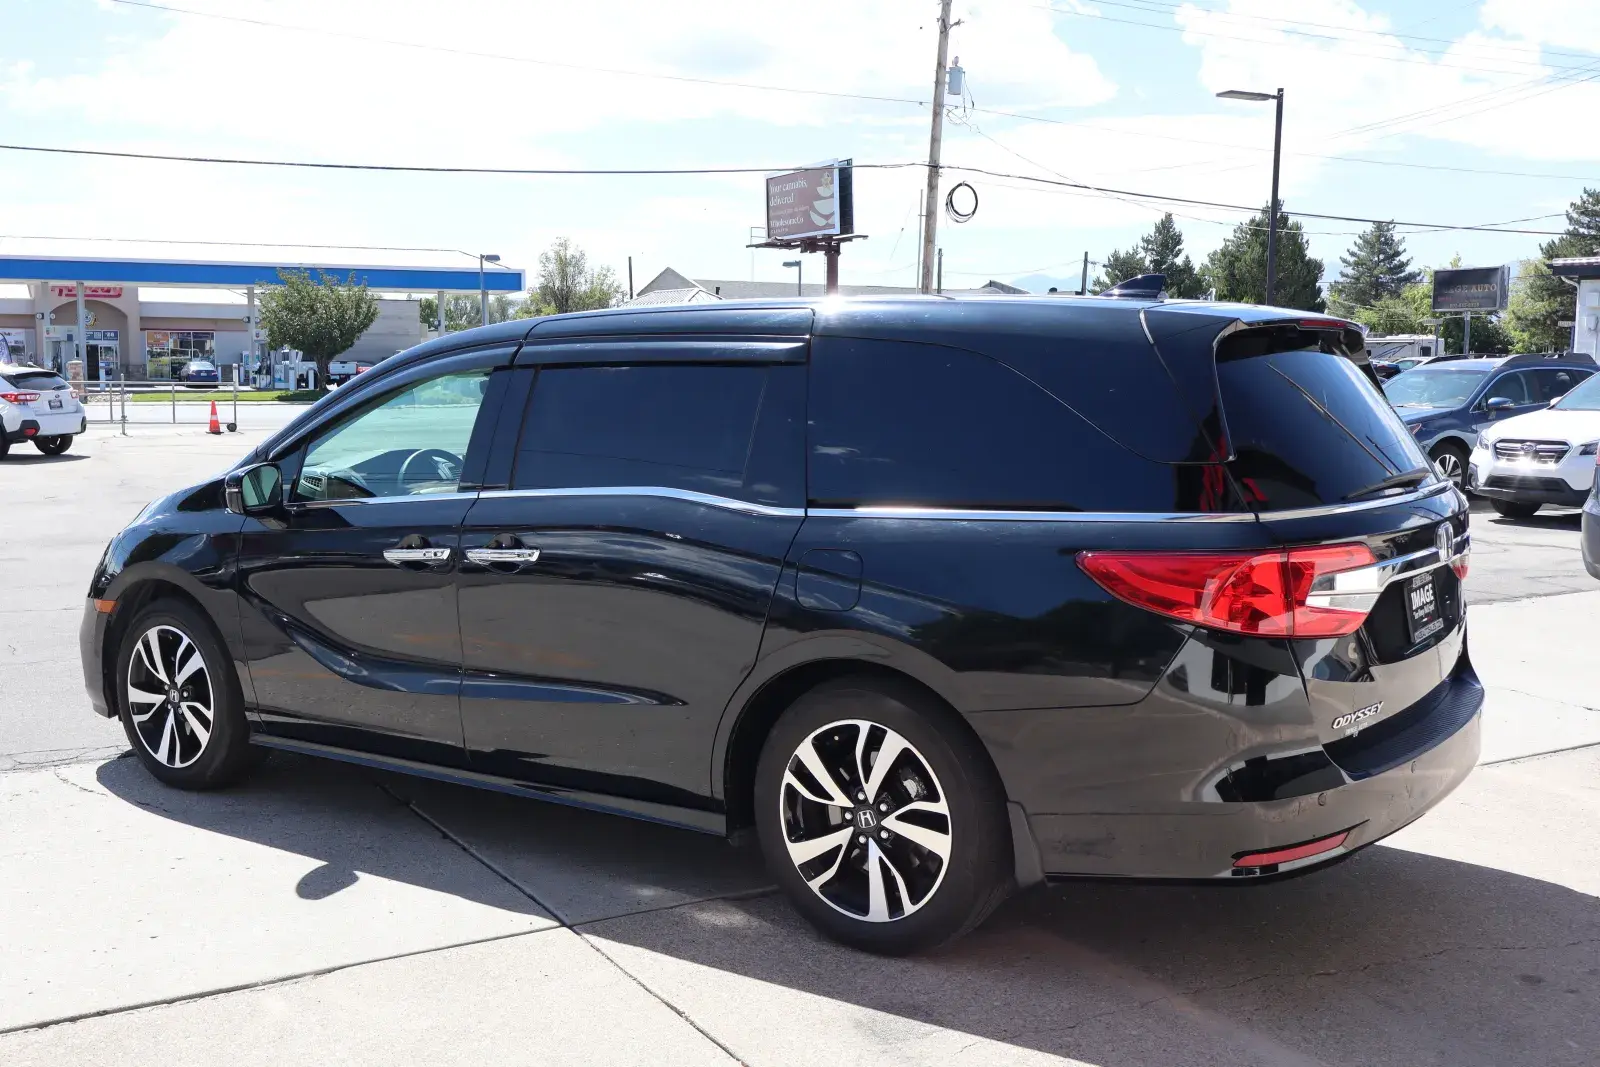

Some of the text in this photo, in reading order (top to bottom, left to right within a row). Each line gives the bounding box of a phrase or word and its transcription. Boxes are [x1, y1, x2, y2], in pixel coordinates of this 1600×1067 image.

[769, 182, 782, 194] Your
[769, 193, 794, 206] delivered
[1470, 283, 1497, 293] AUTO
[1411, 583, 1434, 610] IMAGE
[1331, 701, 1384, 729] ODYSSEY
